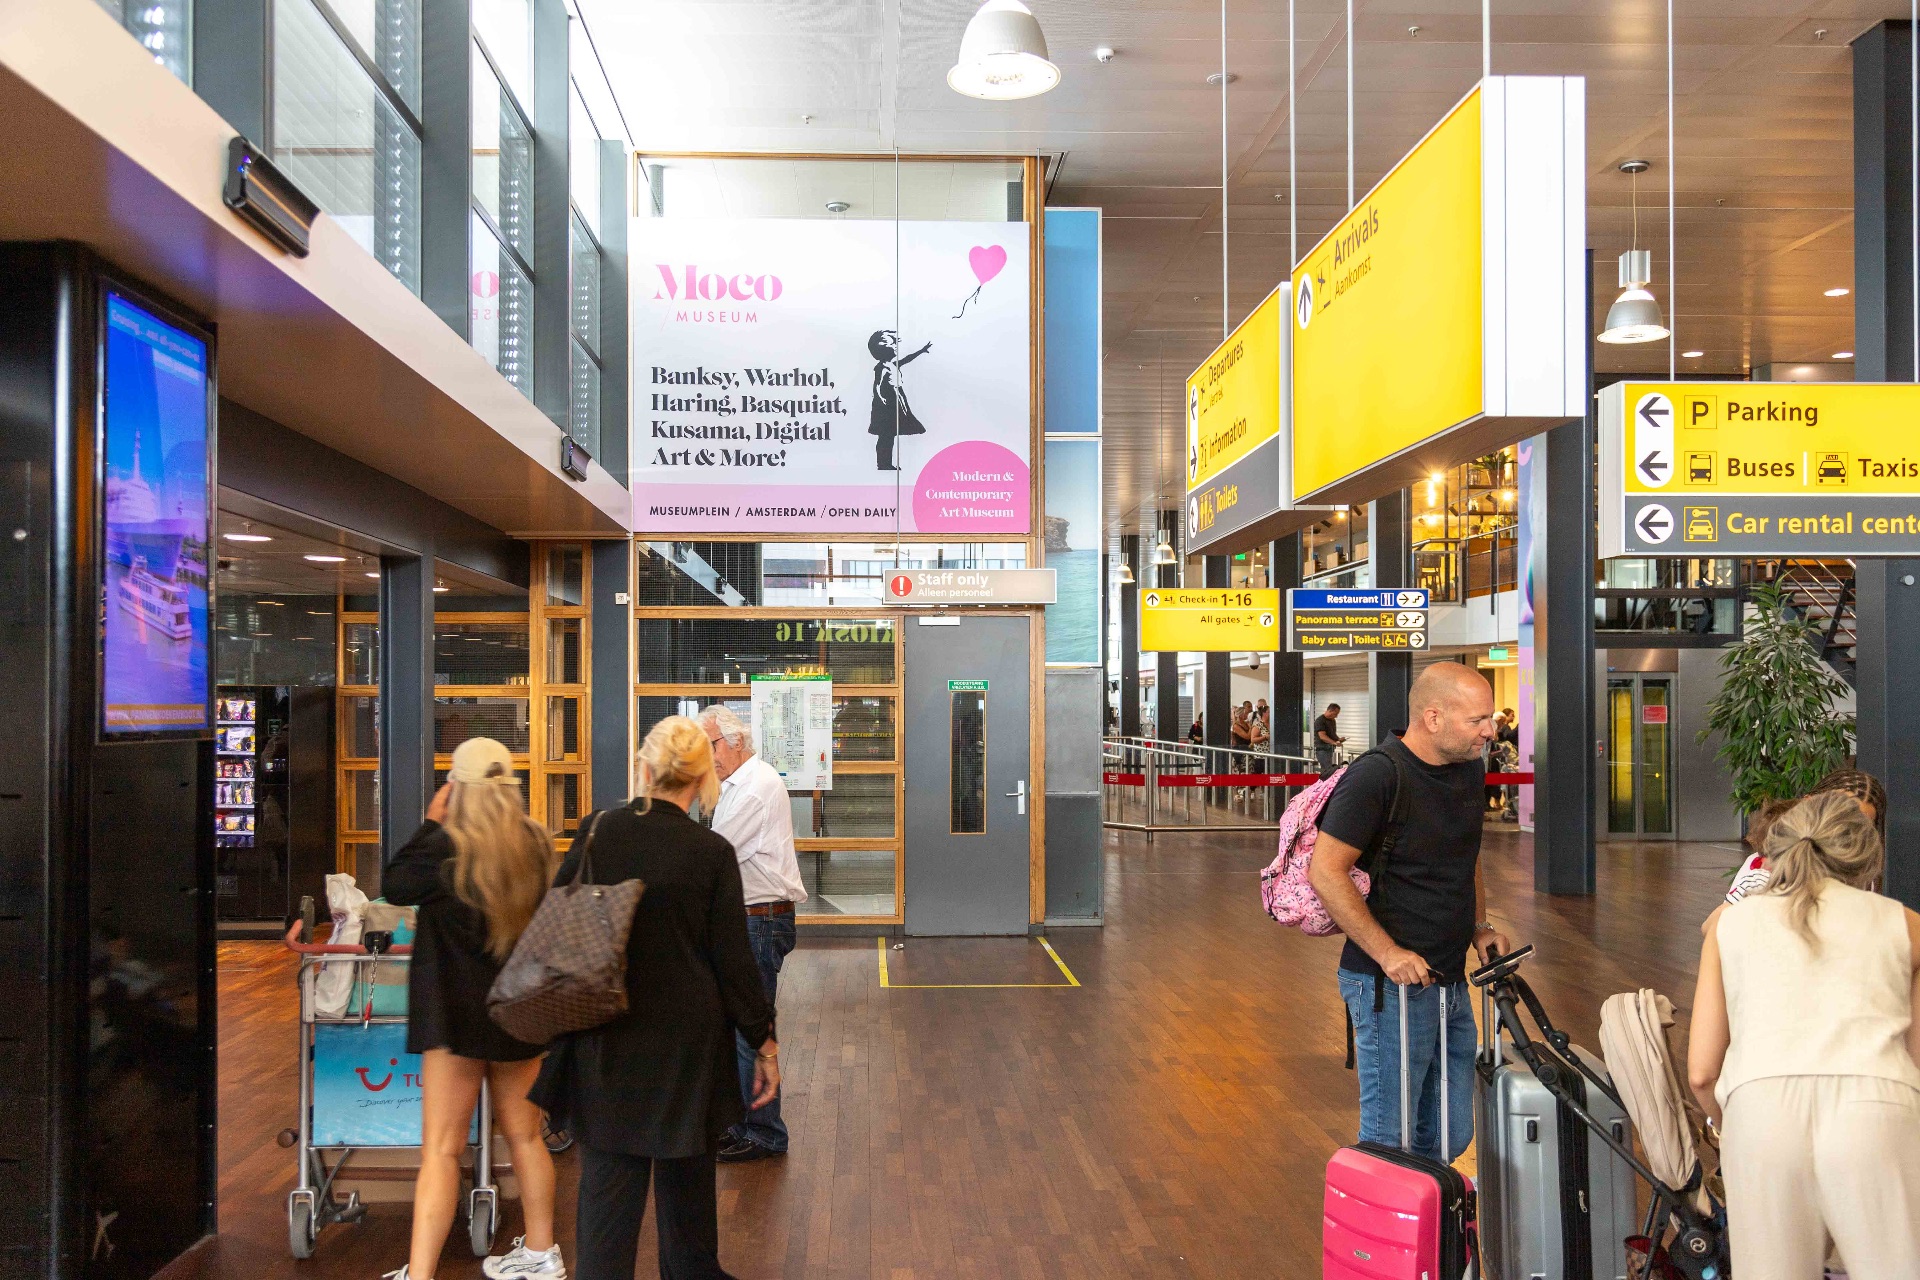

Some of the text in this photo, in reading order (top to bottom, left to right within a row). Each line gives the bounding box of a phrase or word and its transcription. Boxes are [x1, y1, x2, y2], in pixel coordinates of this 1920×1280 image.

[1334, 205, 1379, 270] Arrivals
[652, 264, 783, 301] Moco
[1335, 256, 1372, 300] Aankomst
[676, 310, 758, 323] MUSEUM
[1209, 340, 1244, 387] Departures
[651, 366, 835, 390] Banksy, Warhol,
[651, 392, 847, 418] Haring, Basquiat,
[1727, 400, 1819, 426] Parking
[651, 420, 831, 444] Kusama, Digital
[1209, 416, 1247, 460] Information
[651, 447, 787, 467] Art & More!
[952, 471, 1014, 482] Modern &
[1727, 457, 1920, 478] Buses Taxis
[925, 488, 1014, 502] Contemporary
[1216, 483, 1238, 509] Toilets
[650, 505, 730, 517] MUSEUMPLEIN
[745, 506, 816, 518] AMSTERDAM
[828, 507, 860, 518] OPEN
[864, 507, 896, 518] DAILY
[939, 507, 1015, 518] Art Museum
[1726, 511, 1920, 535] Car rental cent
[918, 572, 989, 588] Staff only
[918, 587, 993, 599] Alleen personeel
[1179, 593, 1252, 606] Check-in 1-16
[1326, 594, 1379, 604] Restaurant
[1200, 614, 1241, 626] All gates
[1296, 615, 1379, 624] Panorama terrace
[1301, 635, 1381, 647] Baby care Toilet
[402, 1073, 423, 1087] TU
